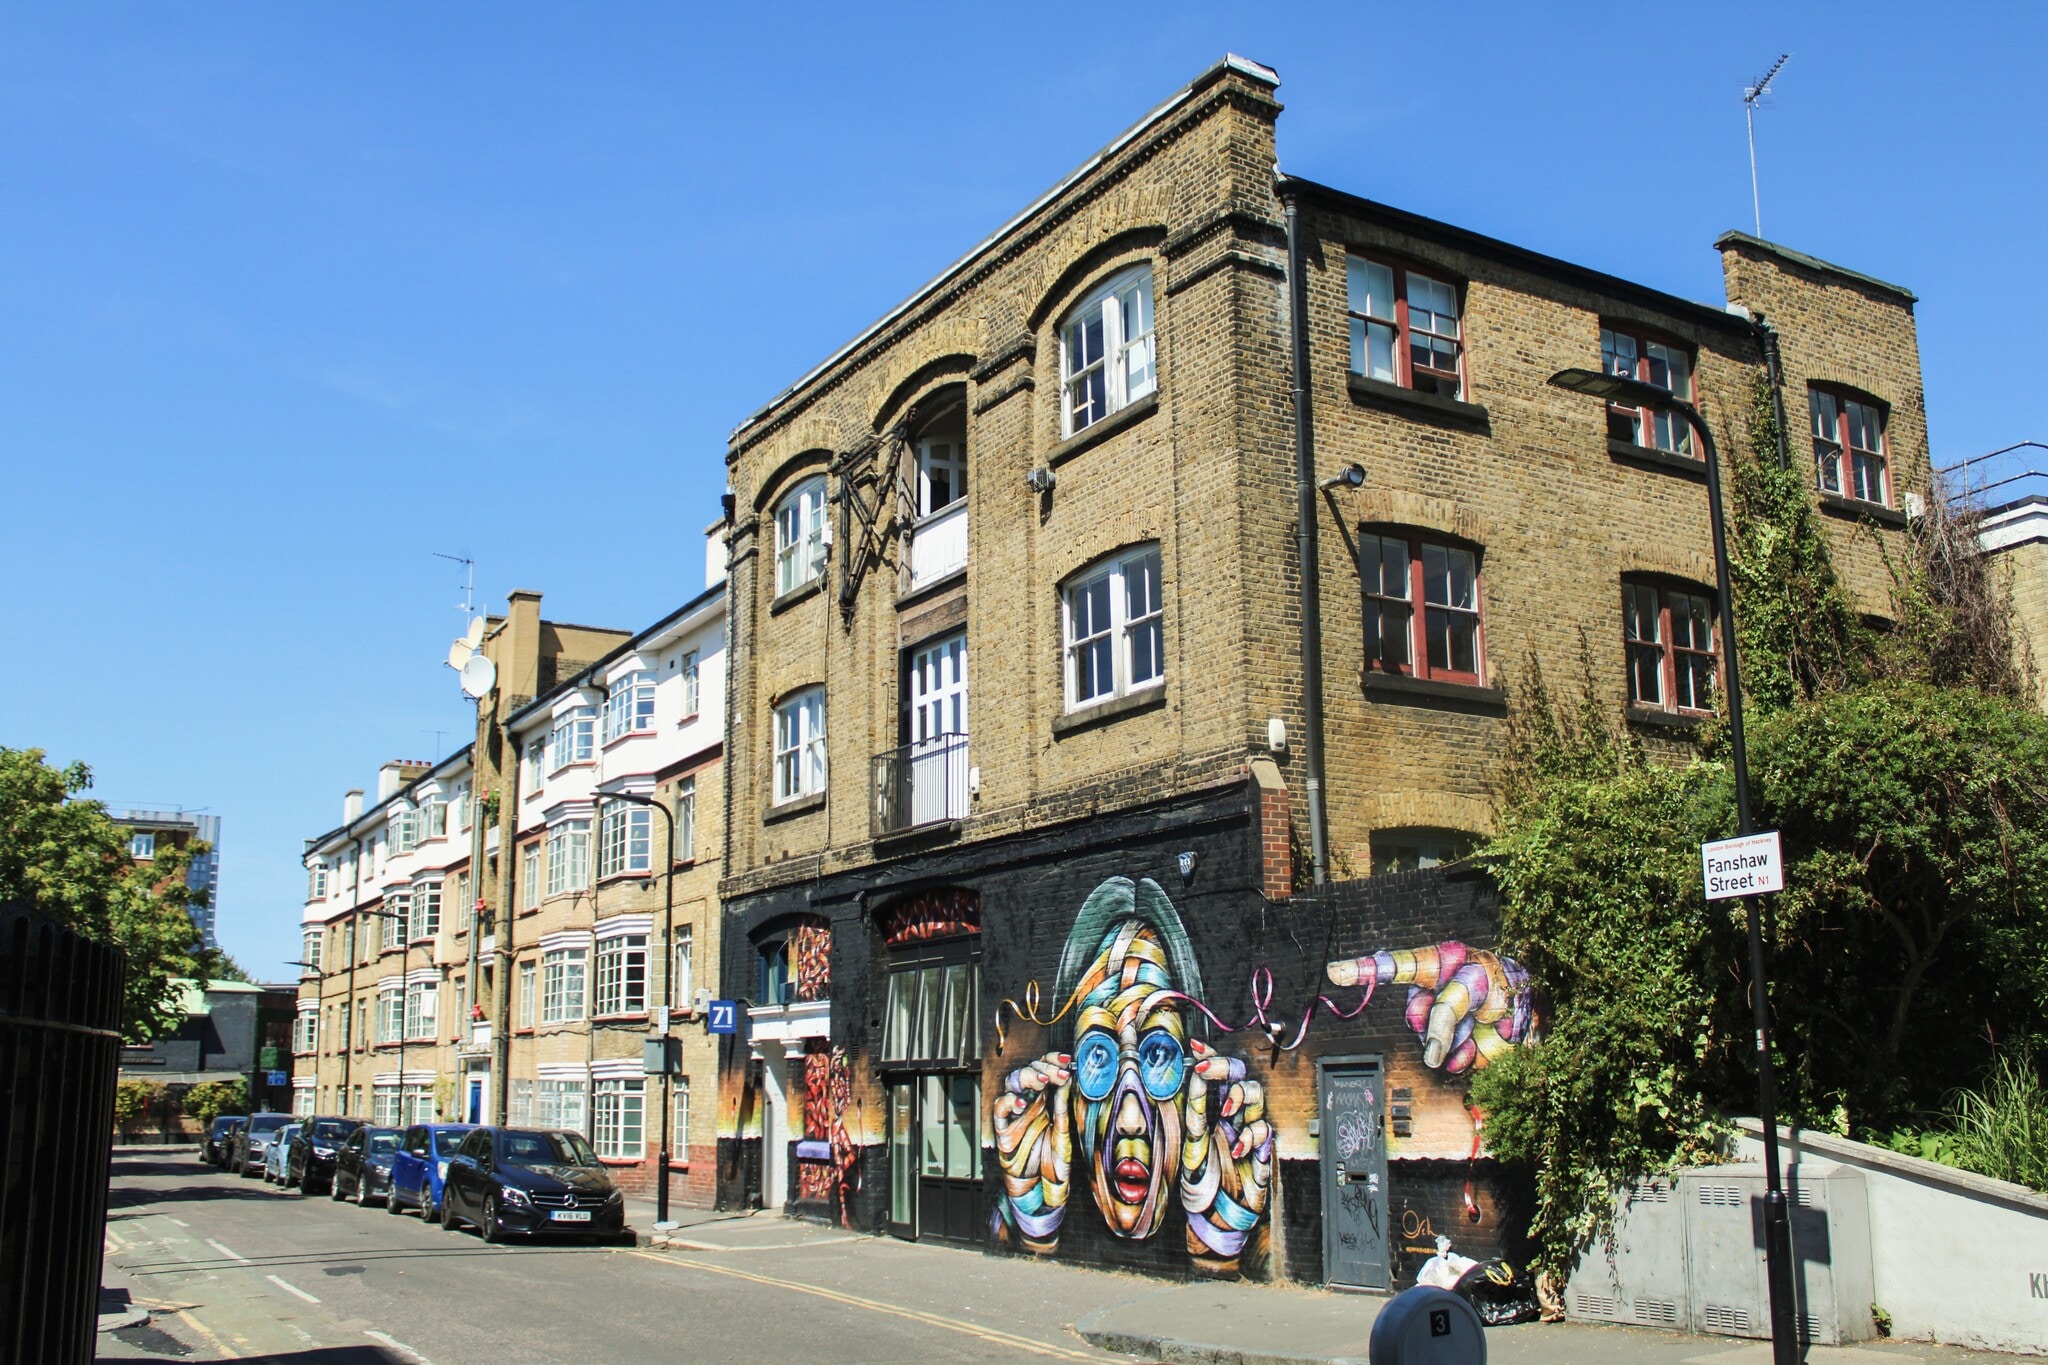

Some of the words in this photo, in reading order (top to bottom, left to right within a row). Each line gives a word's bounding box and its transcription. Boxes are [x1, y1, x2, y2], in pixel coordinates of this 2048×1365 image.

[1751, 838, 1772, 846] Hackney
[1708, 854, 1768, 873] Fanshaw
[1710, 872, 1754, 892] Street
[1758, 875, 1769, 885] N1
[712, 1006, 733, 1025] 71
[1435, 1313, 1446, 1333] 3
